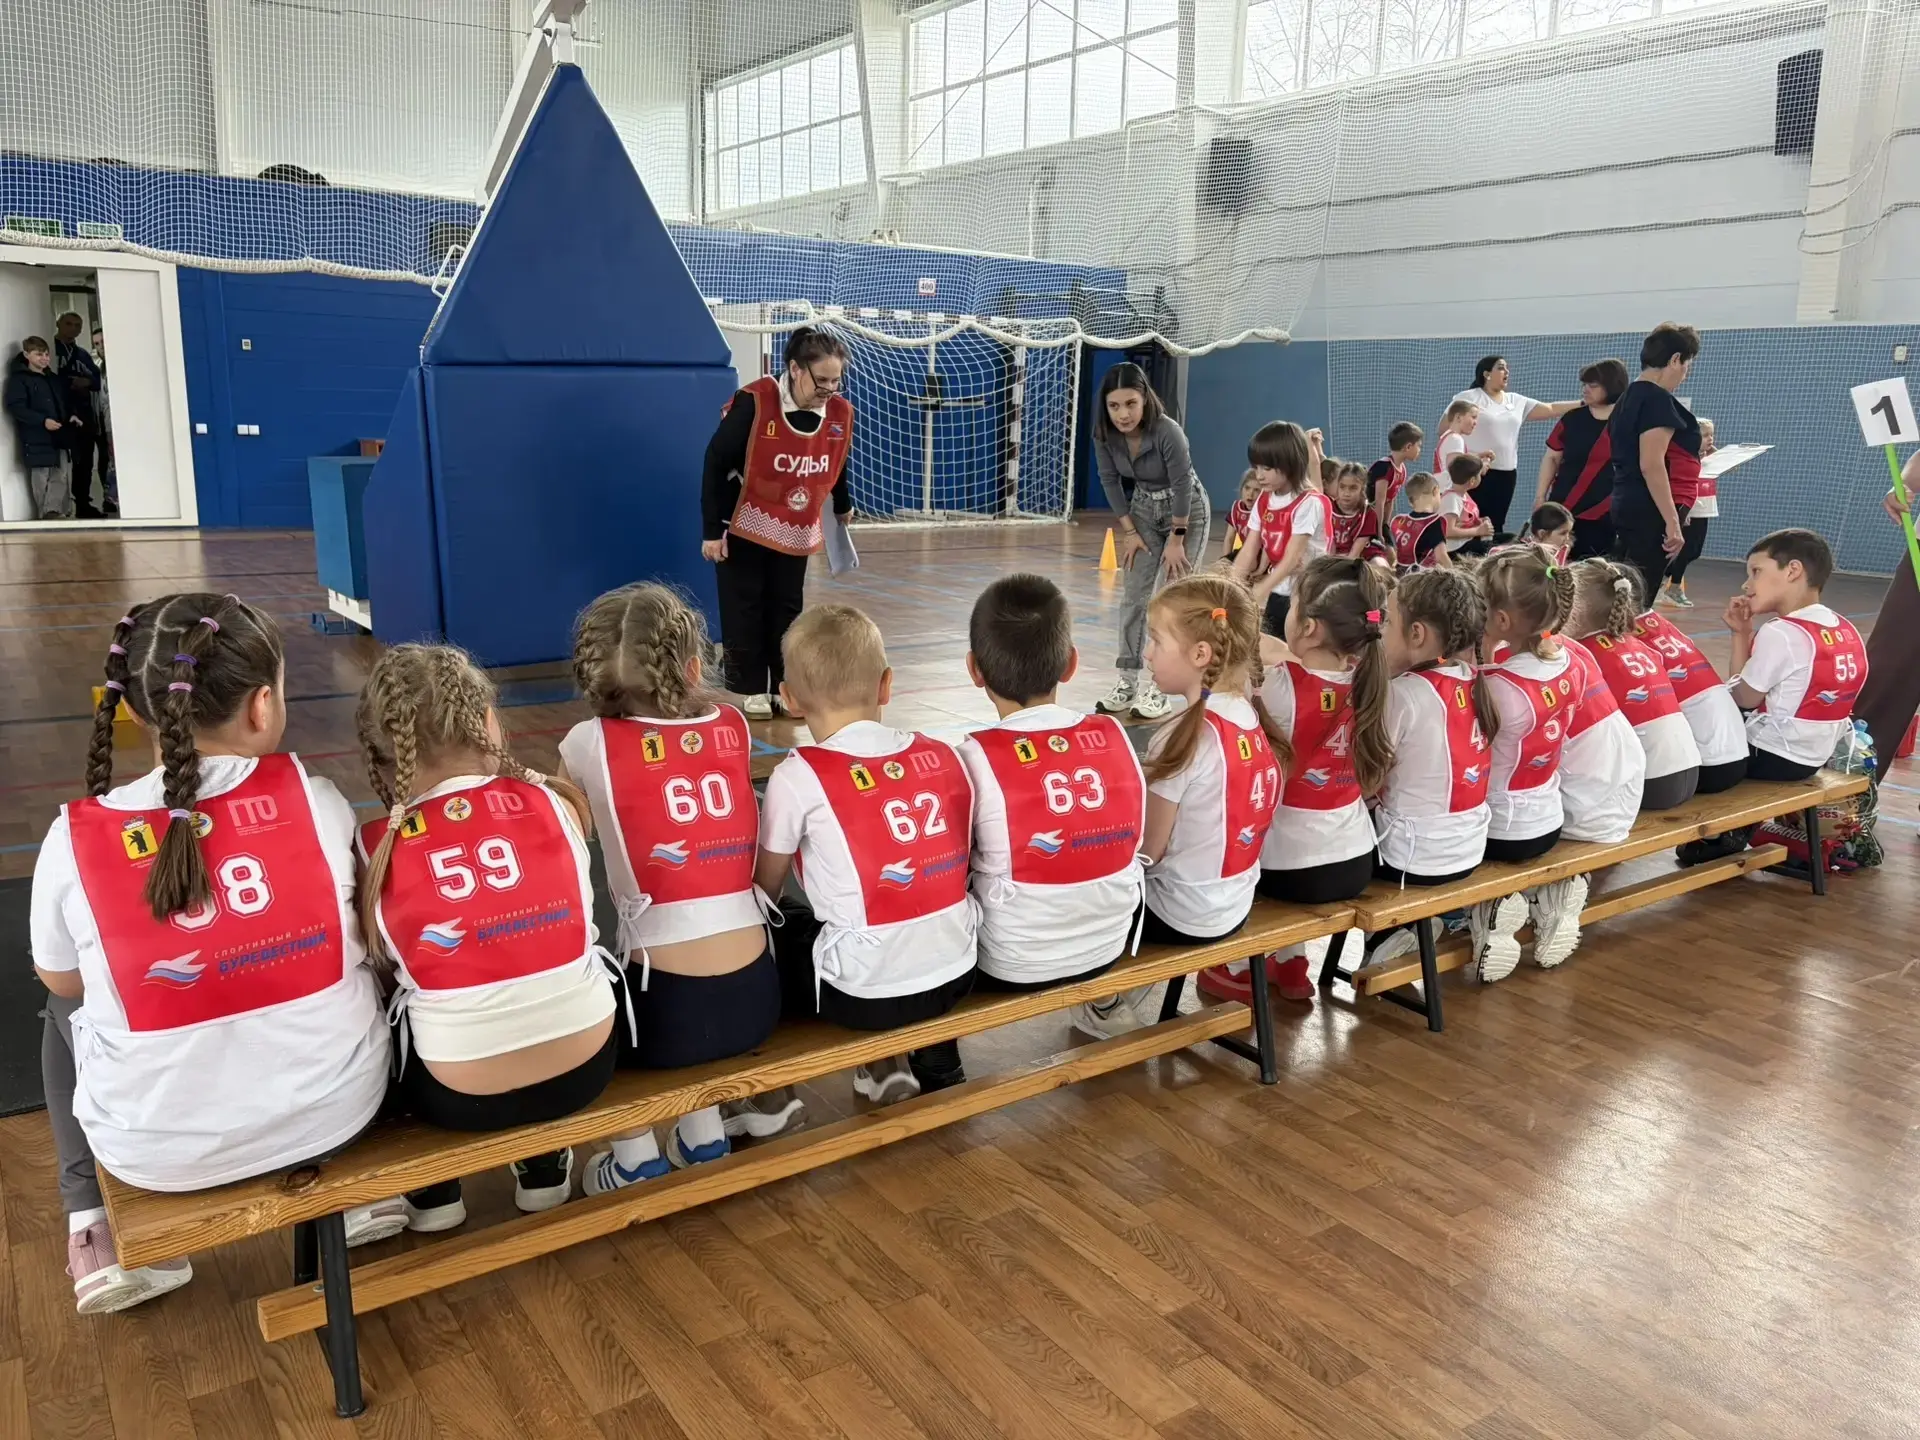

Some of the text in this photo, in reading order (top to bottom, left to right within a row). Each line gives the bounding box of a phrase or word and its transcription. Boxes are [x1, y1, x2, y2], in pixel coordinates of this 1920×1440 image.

[1870, 395, 1901, 436] 1
[773, 453, 830, 477] СУДЬЯ
[1619, 650, 1659, 679] 53
[1652, 634, 1694, 659] 54
[1834, 652, 1858, 682] 55
[1322, 721, 1350, 759] 4
[661, 770, 736, 826] 60
[1040, 765, 1107, 816] 63
[1249, 764, 1278, 813] 47
[226, 795, 278, 828] ГТО
[880, 789, 949, 845] 62
[424, 834, 525, 903] 59
[473, 905, 540, 926] СПОРТИВНЫЙ
[214, 923, 326, 959] СПОРТИВНЫЙ КЛУБ
[218, 931, 327, 973] БУРЕВЕСТНИК
